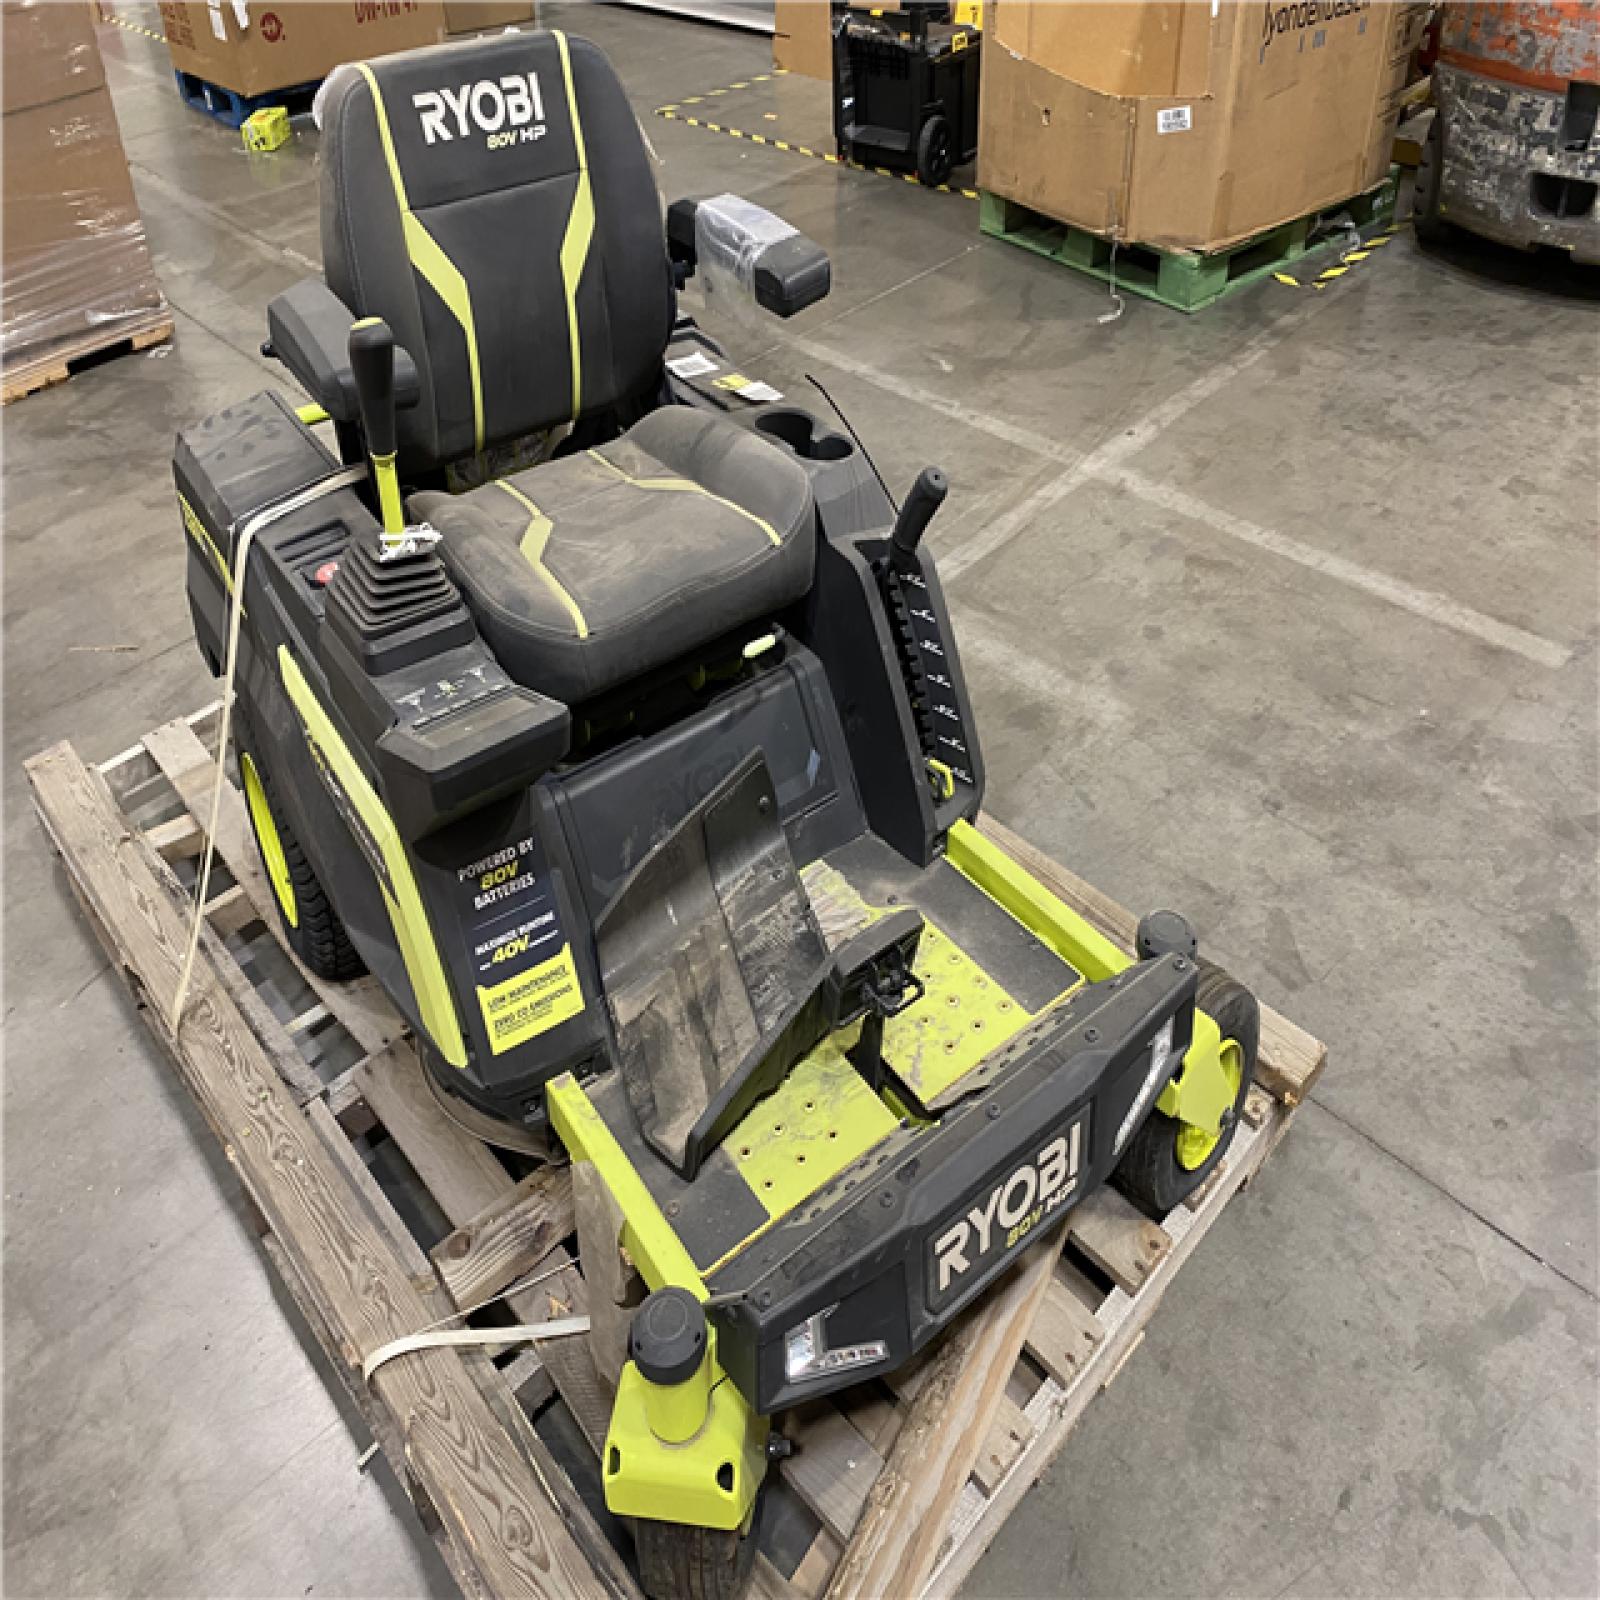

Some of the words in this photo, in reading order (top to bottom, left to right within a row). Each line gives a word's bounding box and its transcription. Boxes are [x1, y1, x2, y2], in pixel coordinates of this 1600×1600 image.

[412, 71, 545, 145] RYOBI
[519, 124, 547, 143] HP
[934, 1121, 1082, 1292] RYOBI
